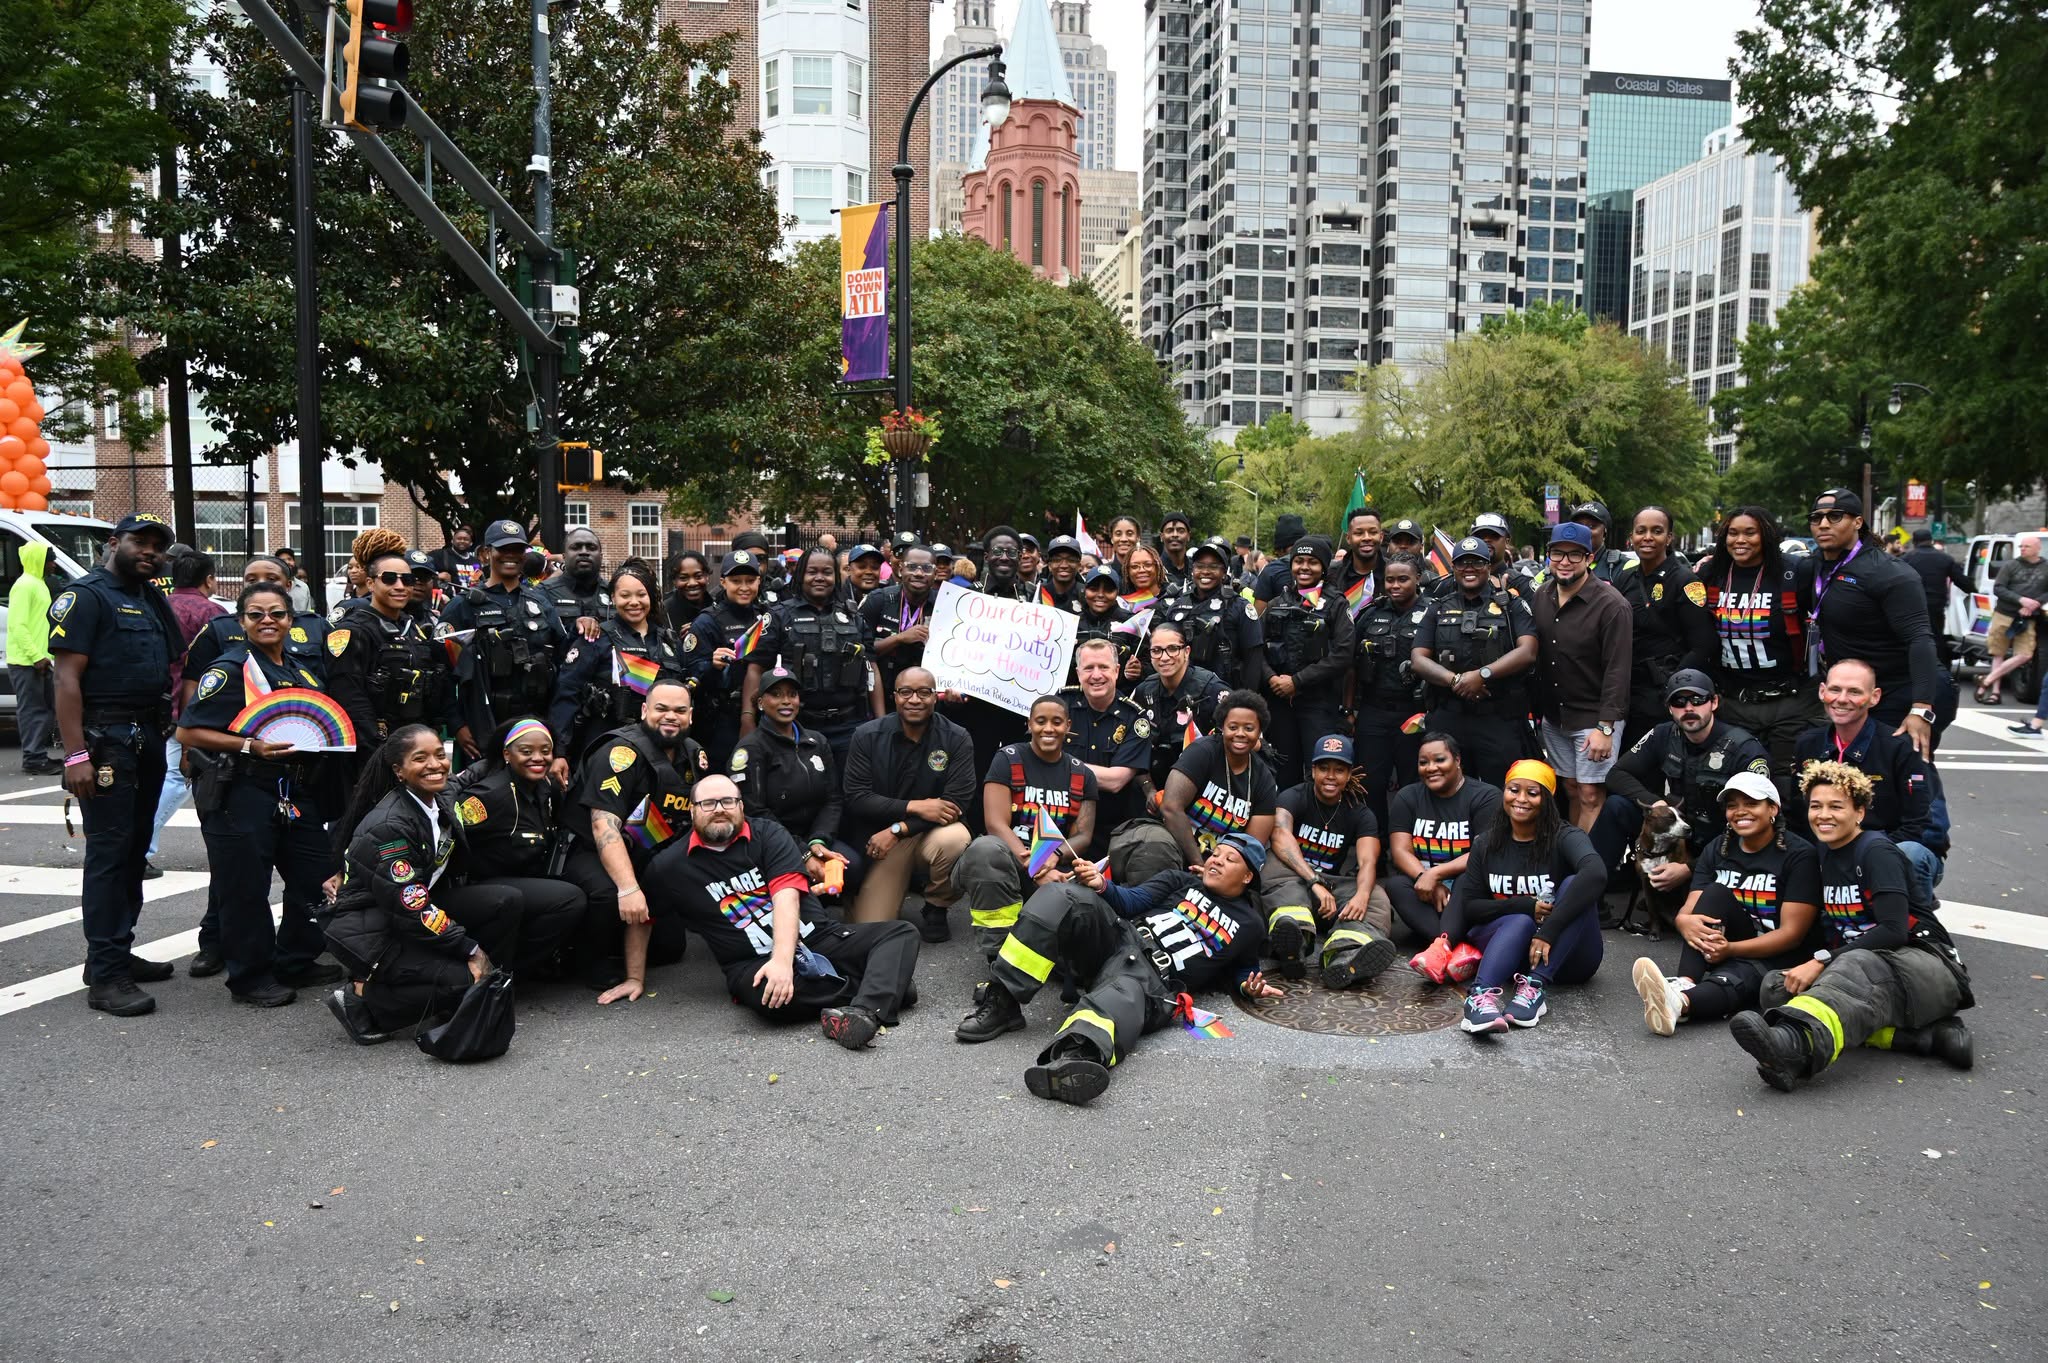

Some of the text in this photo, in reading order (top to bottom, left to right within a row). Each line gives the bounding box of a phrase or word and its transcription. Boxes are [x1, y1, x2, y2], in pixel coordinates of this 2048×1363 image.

[1615, 76, 1704, 95] Coastal States
[847, 270, 882, 284] DOWN
[847, 281, 882, 294] TOWN
[848, 292, 882, 316] ATL
[1717, 592, 1772, 608] WE ARE
[969, 597, 1053, 640] Our City
[965, 625, 1054, 669] Our Duty
[1721, 639, 1777, 669] ATL
[996, 654, 1041, 681] Honor
[937, 676, 954, 688] The
[991, 687, 1012, 704] Police
[1024, 786, 1070, 807] WE ARE
[1202, 780, 1251, 820] WE ARE
[1299, 823, 1345, 849] WE ARE
[1413, 818, 1470, 840] WE ARE
[705, 866, 766, 902] WE ARE
[1488, 873, 1554, 896] WE ARE
[1715, 870, 1777, 891] WE ARE
[1834, 885, 1862, 904] ARE
[1185, 888, 1240, 939] WE ARE
[1145, 911, 1204, 972] ATL
